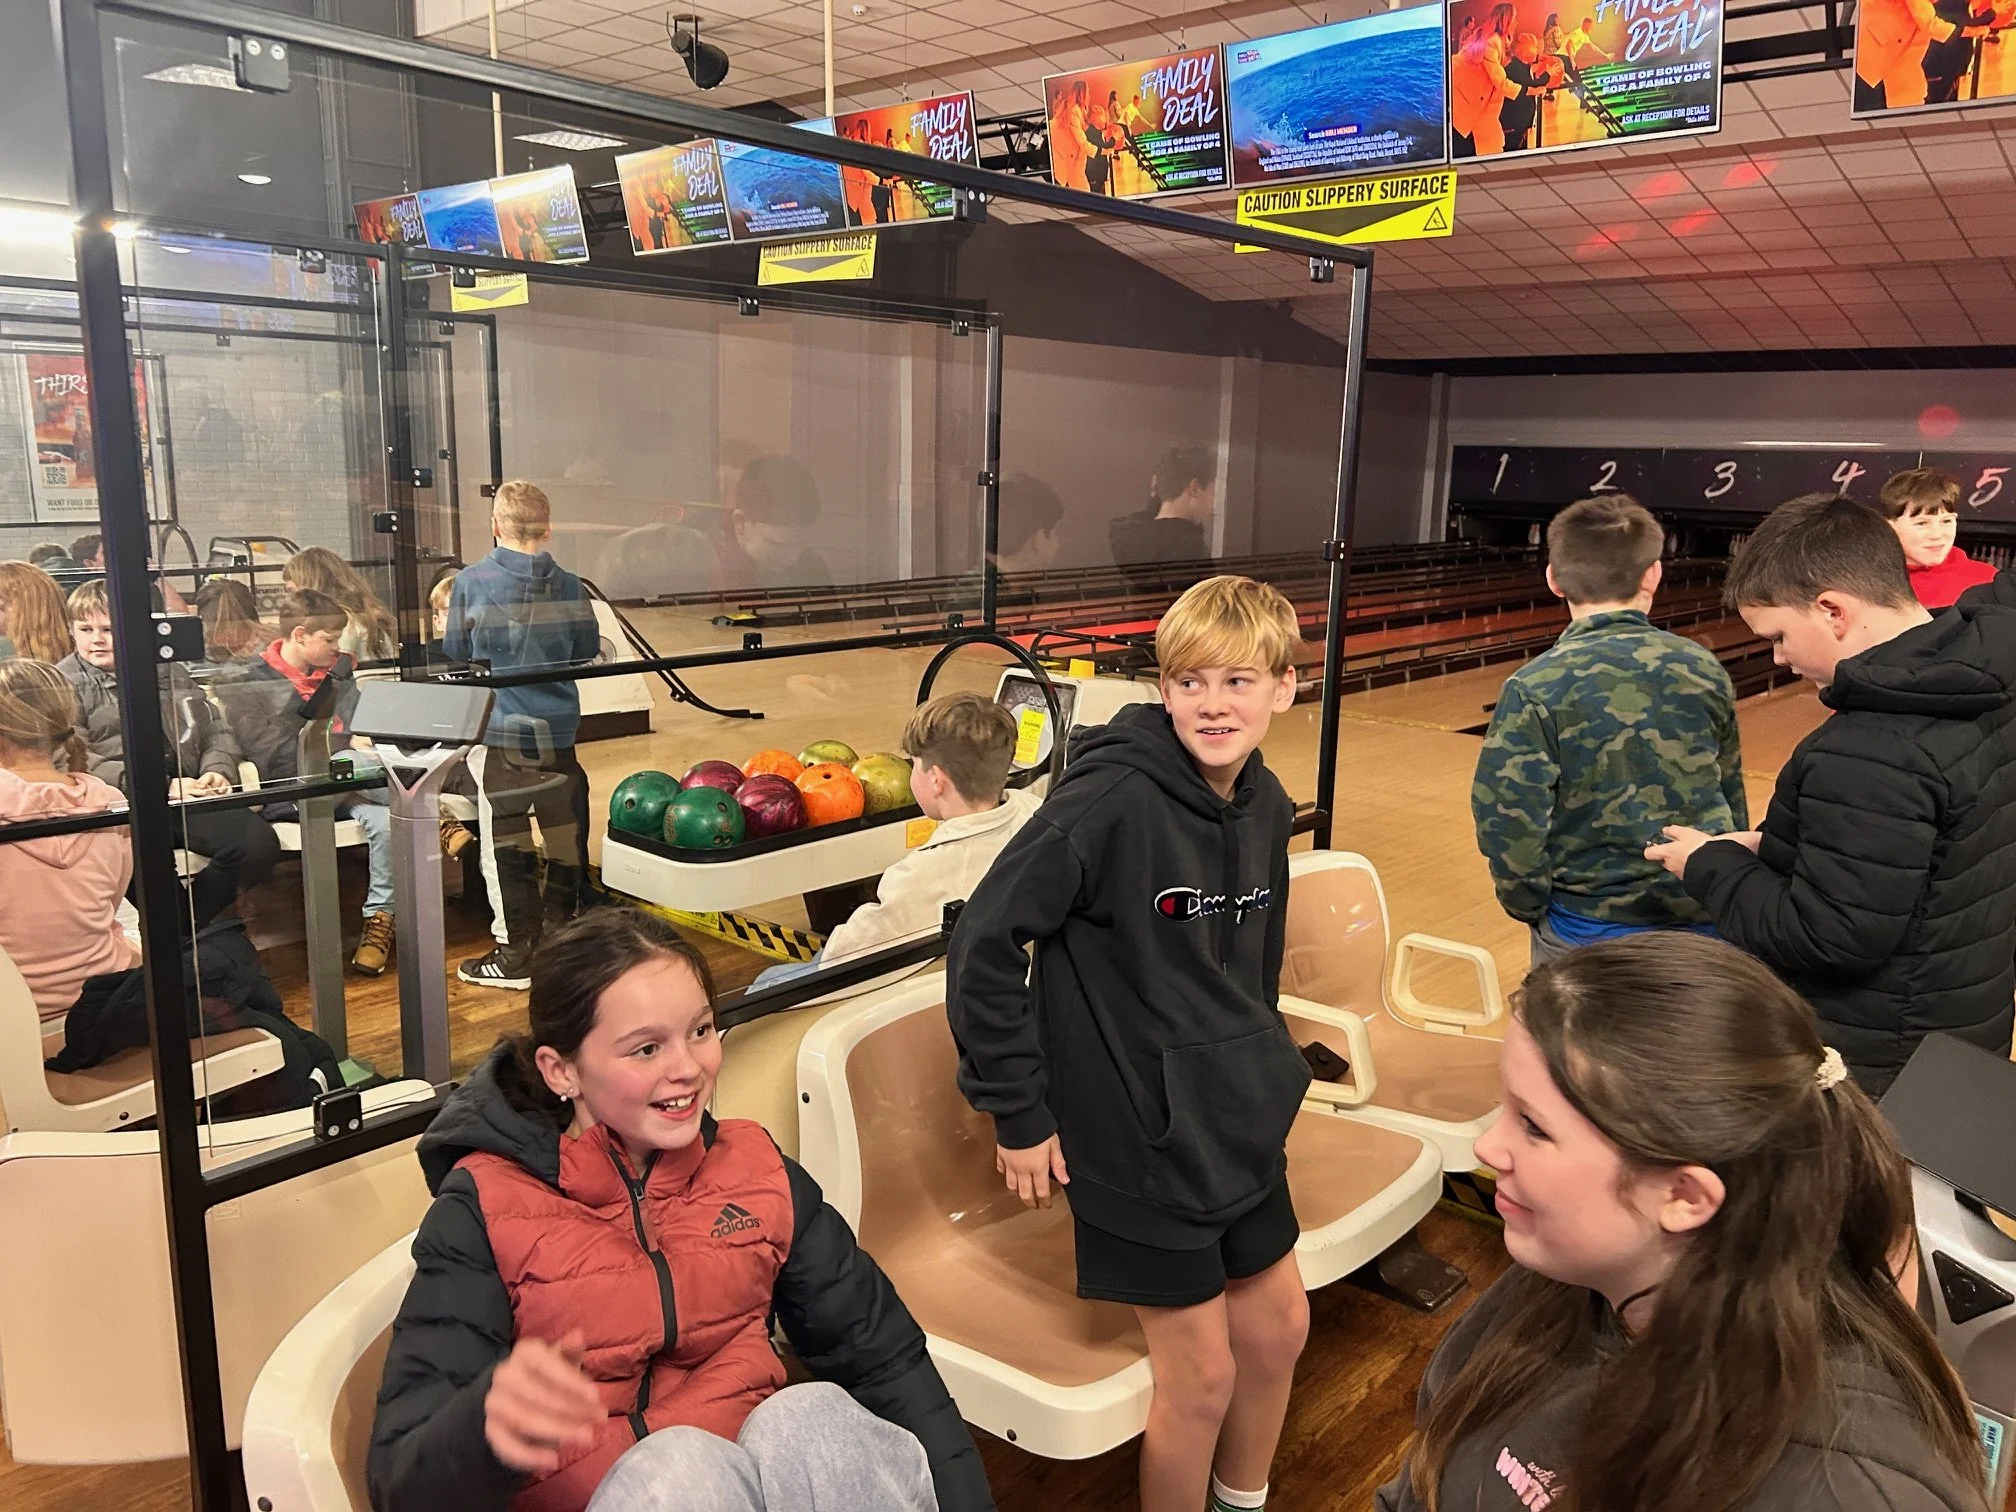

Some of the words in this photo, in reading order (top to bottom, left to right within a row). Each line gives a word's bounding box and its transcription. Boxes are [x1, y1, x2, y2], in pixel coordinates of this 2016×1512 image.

[1596, 0, 1702, 23] FAM
[1625, 4, 1713, 62] DEAL
[1140, 53, 1215, 100] FAMILY
[1602, 72, 1637, 84] GAME
[1638, 68, 1655, 79] OF
[1656, 61, 1712, 77] BOWLING
[1602, 84, 1627, 96] FOR
[1627, 82, 1637, 91] A
[1638, 75, 1682, 89] FAMILY
[1684, 73, 1702, 83] OF
[1703, 71, 1711, 80] 4
[910, 98, 967, 138] FAMILY
[1162, 88, 1219, 132] DEAL
[1621, 114, 1633, 125] ASK
[1633, 114, 1641, 123] AT
[1641, 110, 1673, 122] RECEPTION
[1674, 108, 1686, 118] FOR
[1686, 105, 1710, 116] DETAILS
[929, 129, 973, 163] DEAL
[1173, 137, 1184, 145] OF
[1185, 132, 1220, 144] BOWLING
[1174, 142, 1202, 154] FAMILY
[1203, 141, 1215, 150] OF
[1308, 131, 1325, 140] Search
[673, 144, 712, 176] FAMILY
[688, 170, 719, 201] DEAL
[1245, 191, 1301, 213] CAUTION
[1306, 182, 1375, 207] SLIPPERY
[1380, 175, 1450, 201] SURFACE
[763, 242, 793, 259] CAUTION
[795, 239, 831, 256] SLIPPERY
[833, 235, 872, 252] SURFACE
[1492, 453, 1508, 494] 1
[1590, 461, 1618, 491] 2
[1705, 461, 1737, 498] 3
[1832, 460, 1866, 496] 4
[1968, 467, 2012, 508] 5
[47, 499, 65, 507] WANT
[711, 1217, 760, 1238] adidas
